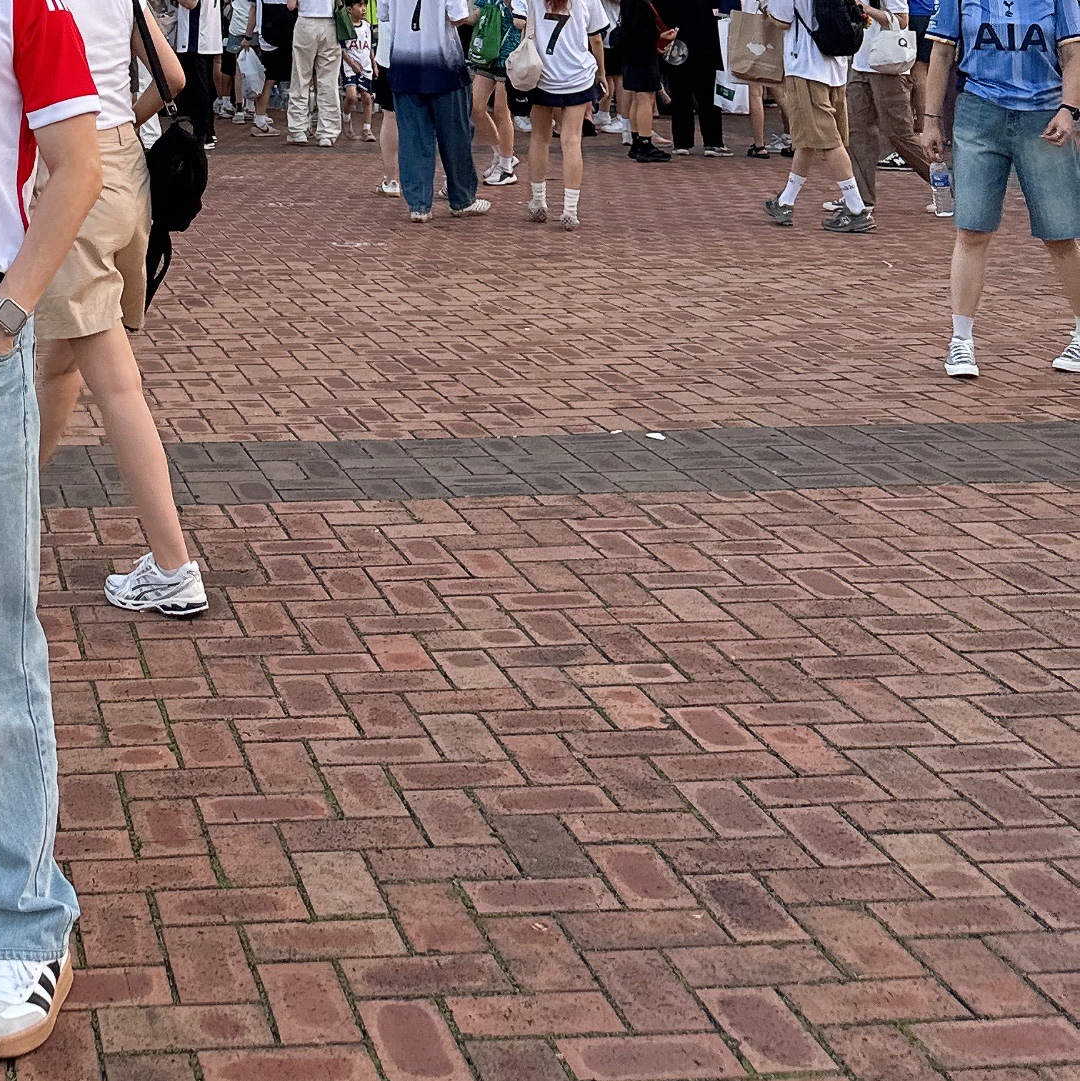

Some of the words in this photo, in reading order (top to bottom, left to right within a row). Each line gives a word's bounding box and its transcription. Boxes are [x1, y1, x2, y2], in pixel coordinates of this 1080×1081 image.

[543, 12, 571, 56] 7
[898, 37, 908, 48] Q
[973, 22, 1048, 52] AIA
[348, 40, 370, 51] AIA
